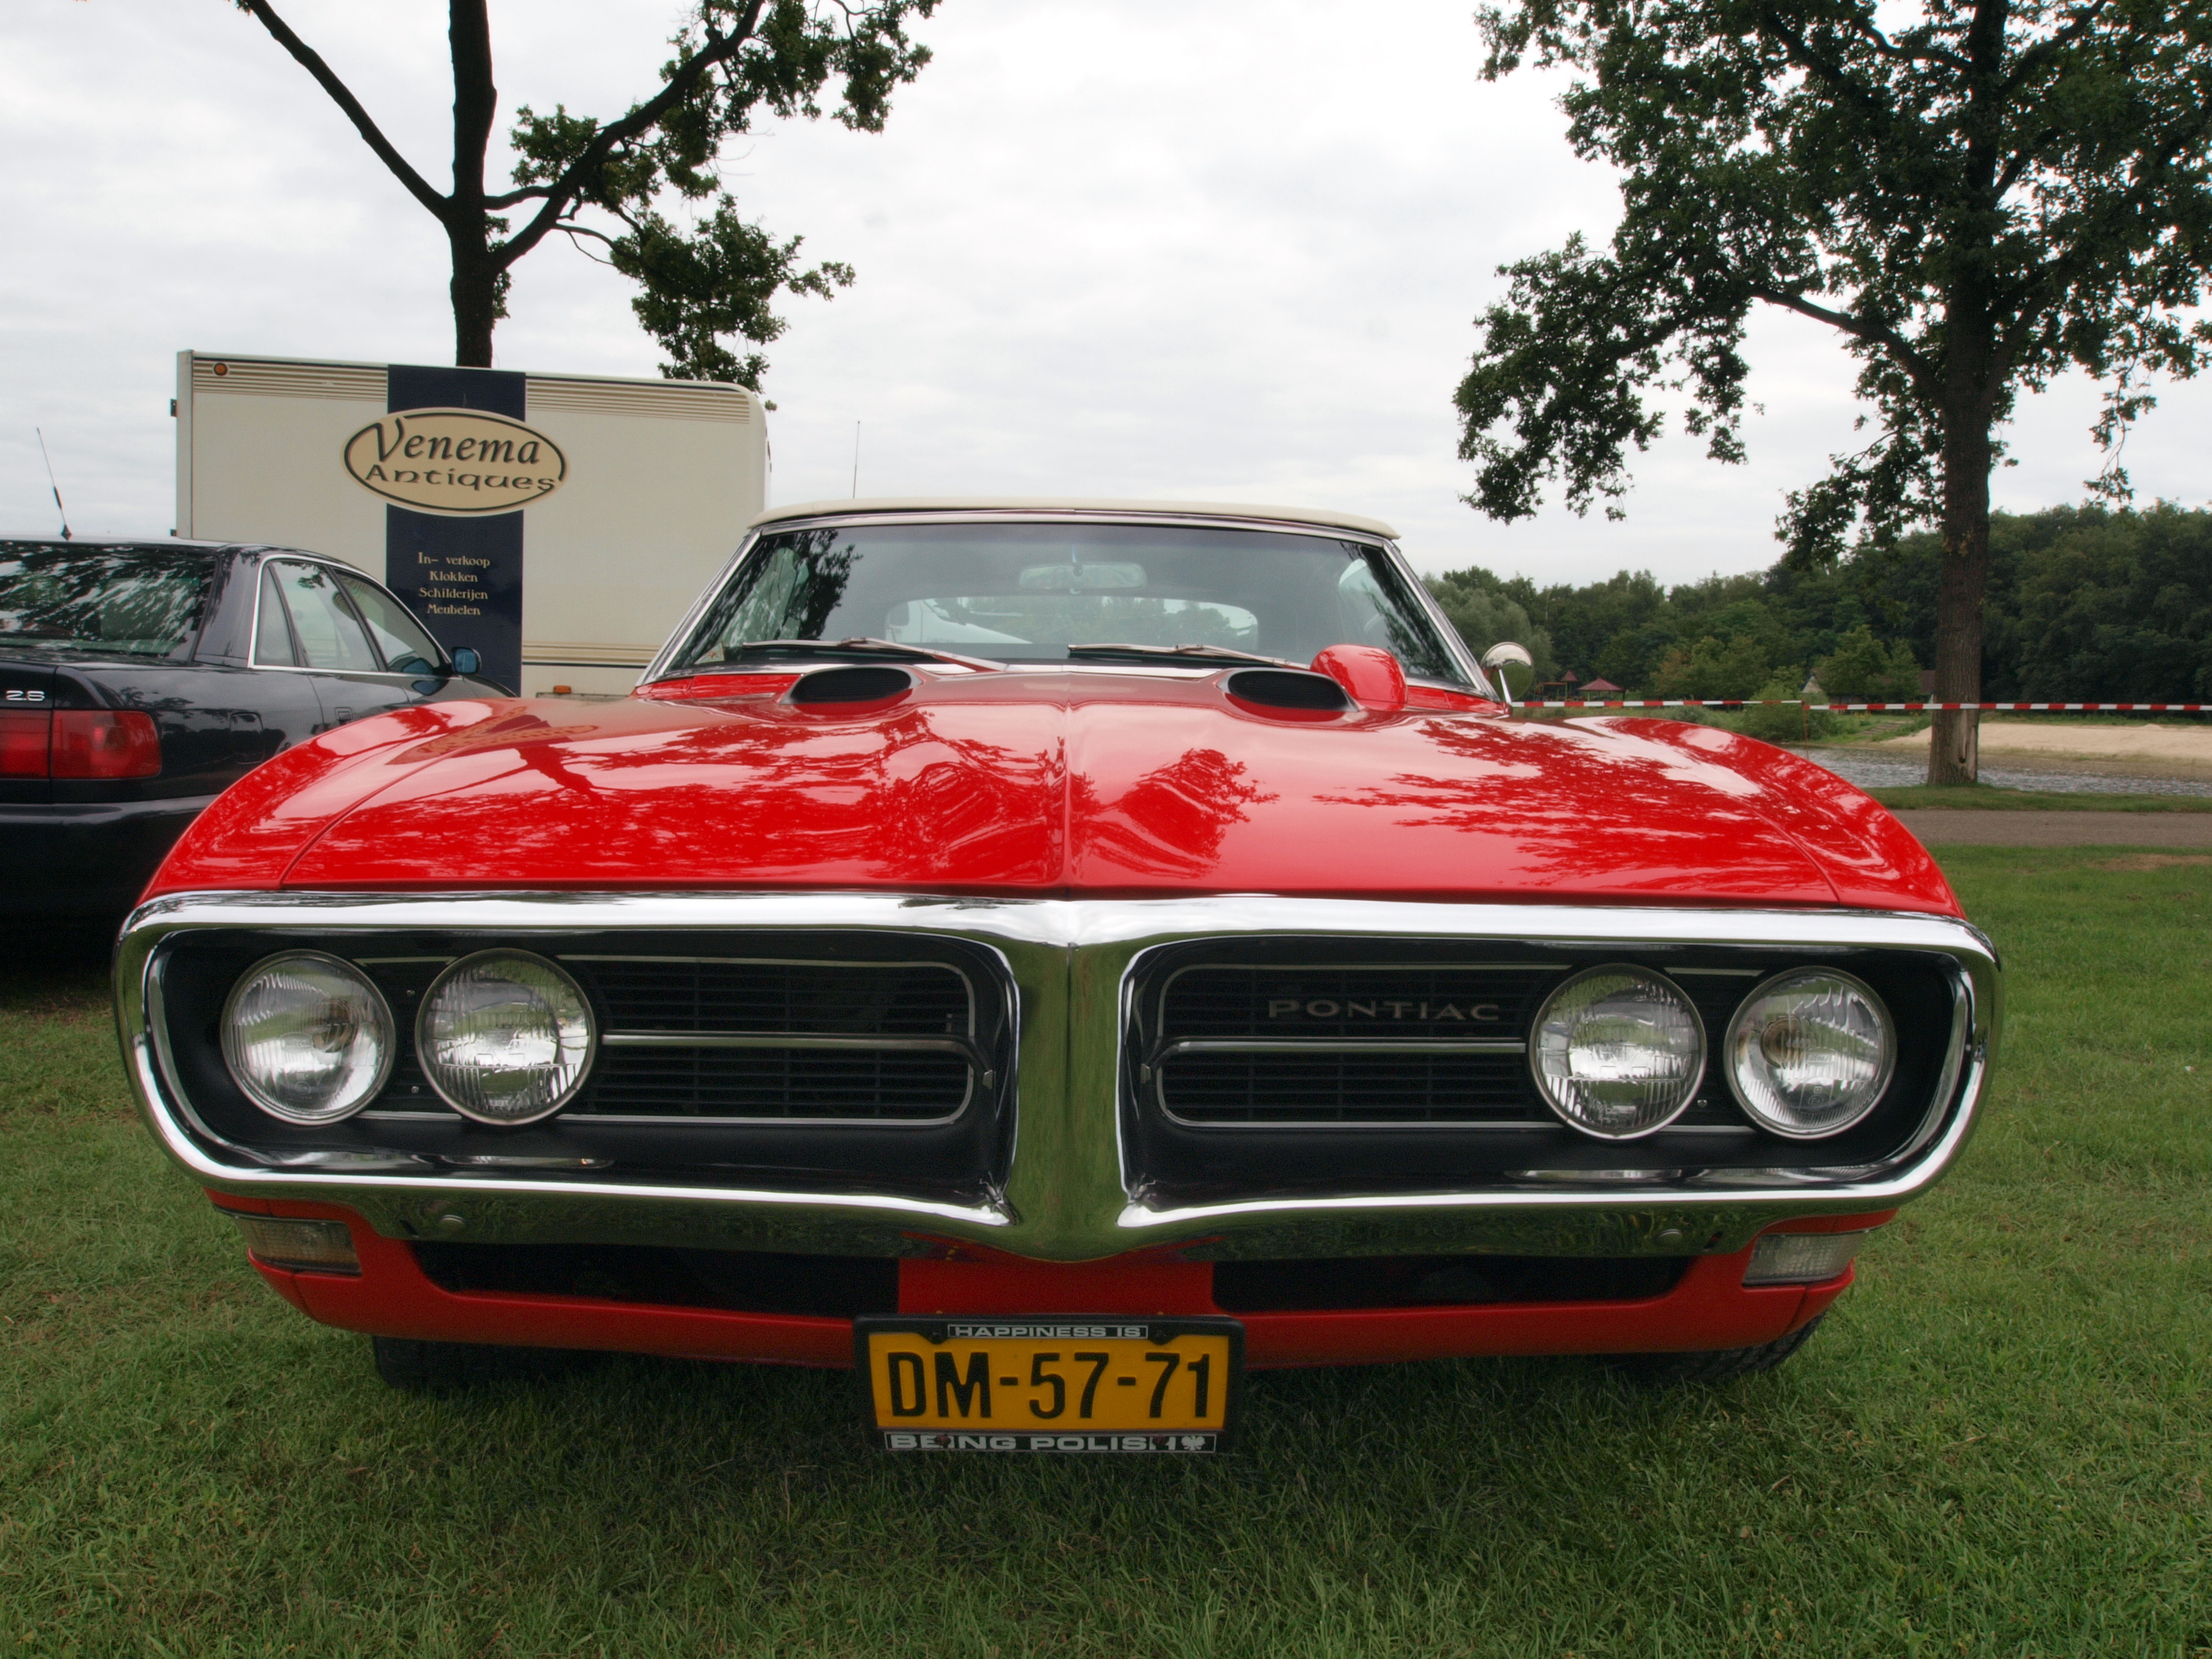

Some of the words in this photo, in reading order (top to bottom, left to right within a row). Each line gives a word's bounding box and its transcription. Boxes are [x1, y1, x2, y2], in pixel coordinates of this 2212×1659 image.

[371, 418, 540, 464] Venema
[366, 464, 556, 491] Antiques
[418, 552, 439, 564] In-
[446, 555, 491, 569] verkoop
[429, 571, 478, 582] Klokken
[419, 587, 488, 602] Schilderijen
[427, 604, 481, 615] Meubelen
[1269, 1000, 1500, 1021] PONTIAC
[954, 1326, 1108, 1338] HAPPINESS
[1116, 1327, 1142, 1338] IS
[887, 1352, 1210, 1419] DM-57-71
[891, 1435, 1017, 1450] BEING
